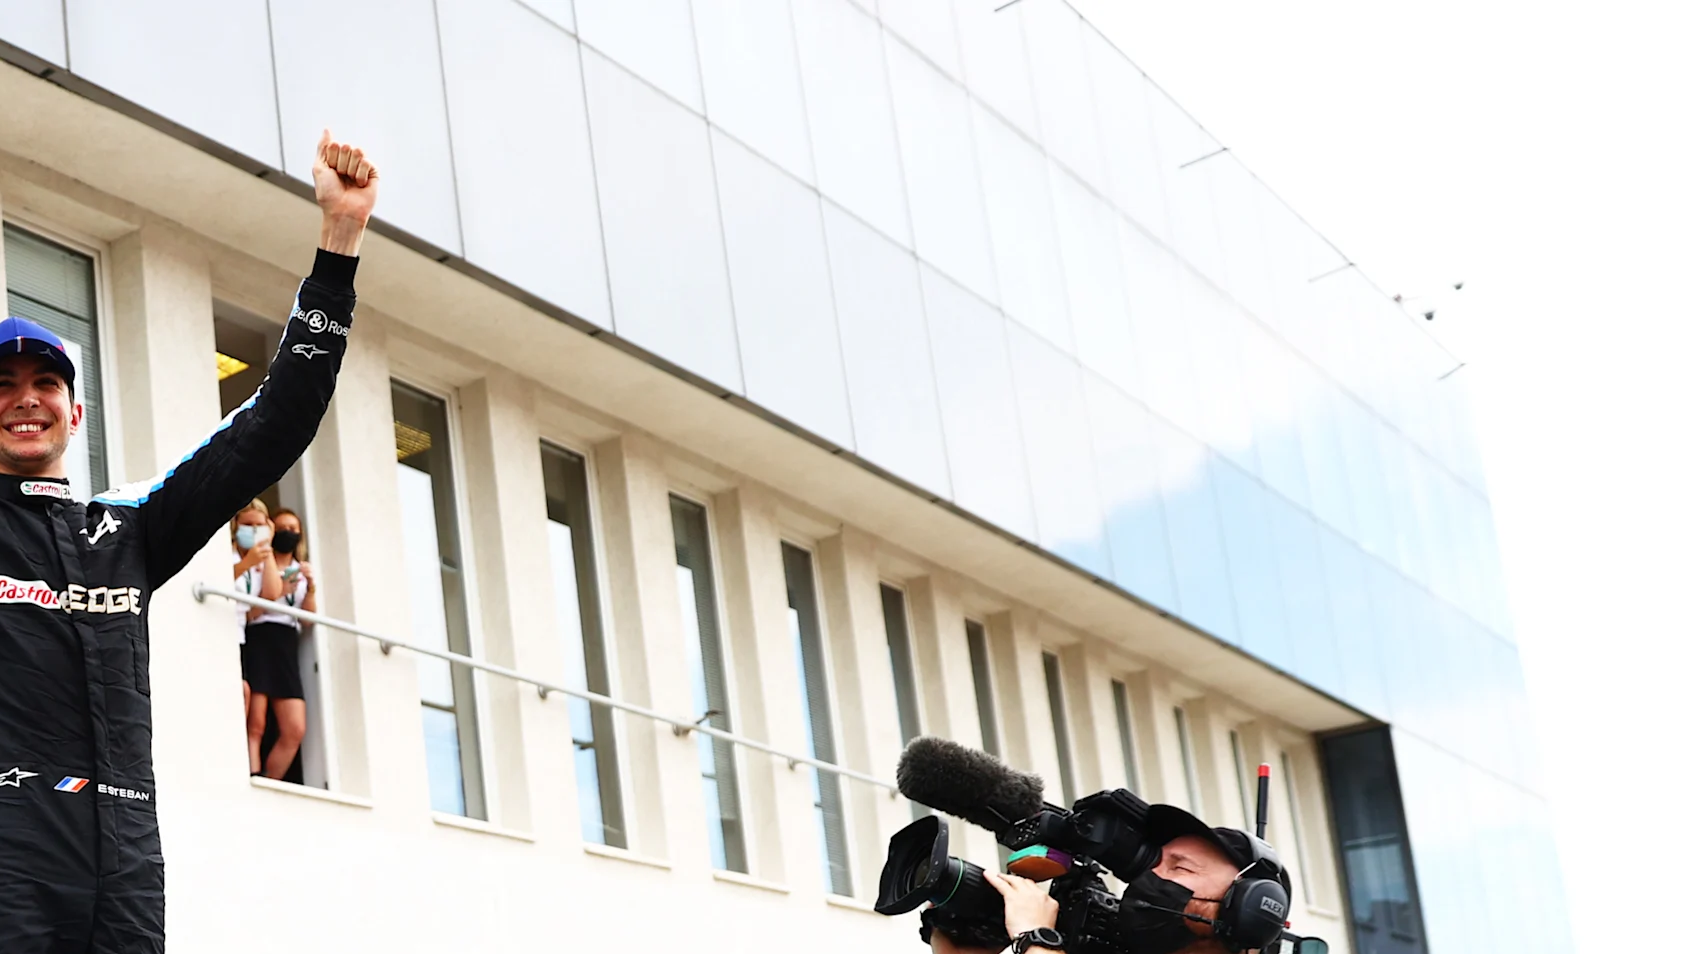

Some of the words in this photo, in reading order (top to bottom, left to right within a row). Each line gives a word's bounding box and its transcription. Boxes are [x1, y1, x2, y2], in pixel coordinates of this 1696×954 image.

[328, 320, 350, 336] Ros
[68, 584, 142, 615] EDGE
[98, 784, 149, 801] ESTEBAN
[1263, 898, 1283, 917] ALEX
